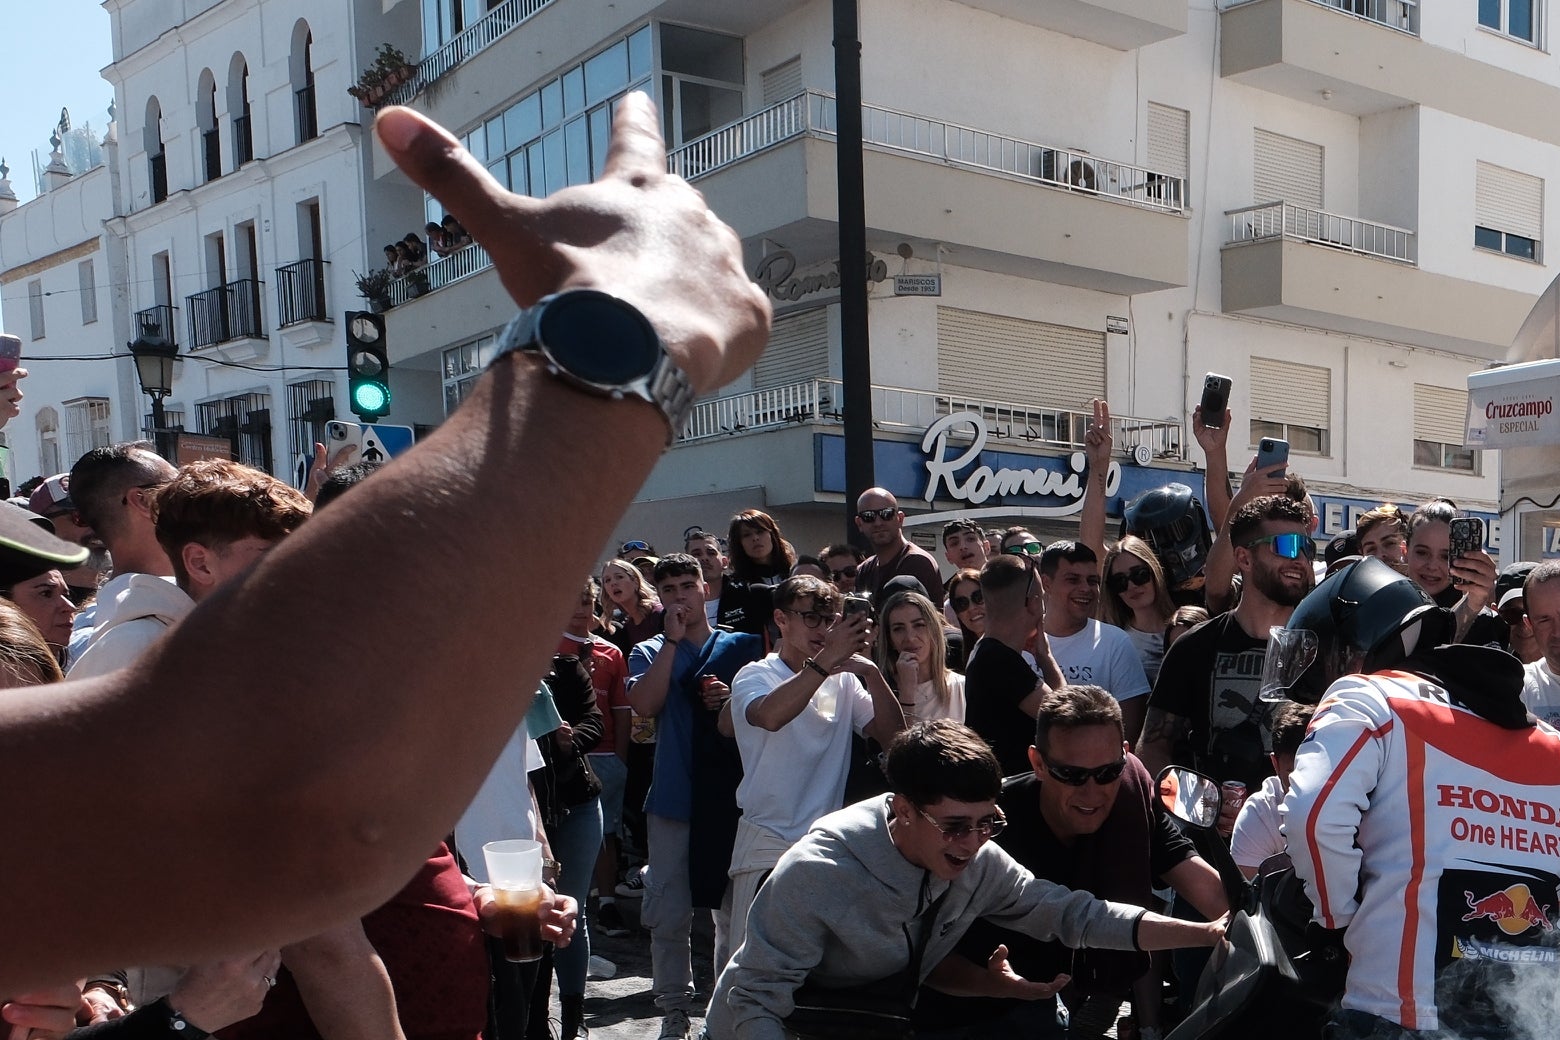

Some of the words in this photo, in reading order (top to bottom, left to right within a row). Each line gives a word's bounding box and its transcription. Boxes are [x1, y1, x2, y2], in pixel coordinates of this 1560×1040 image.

[1485, 399, 1553, 419] Cruzcampo
[1499, 420, 1540, 434] ESPECIAL
[1451, 817, 1496, 846] One
[1480, 946, 1555, 962] MICHELIN
